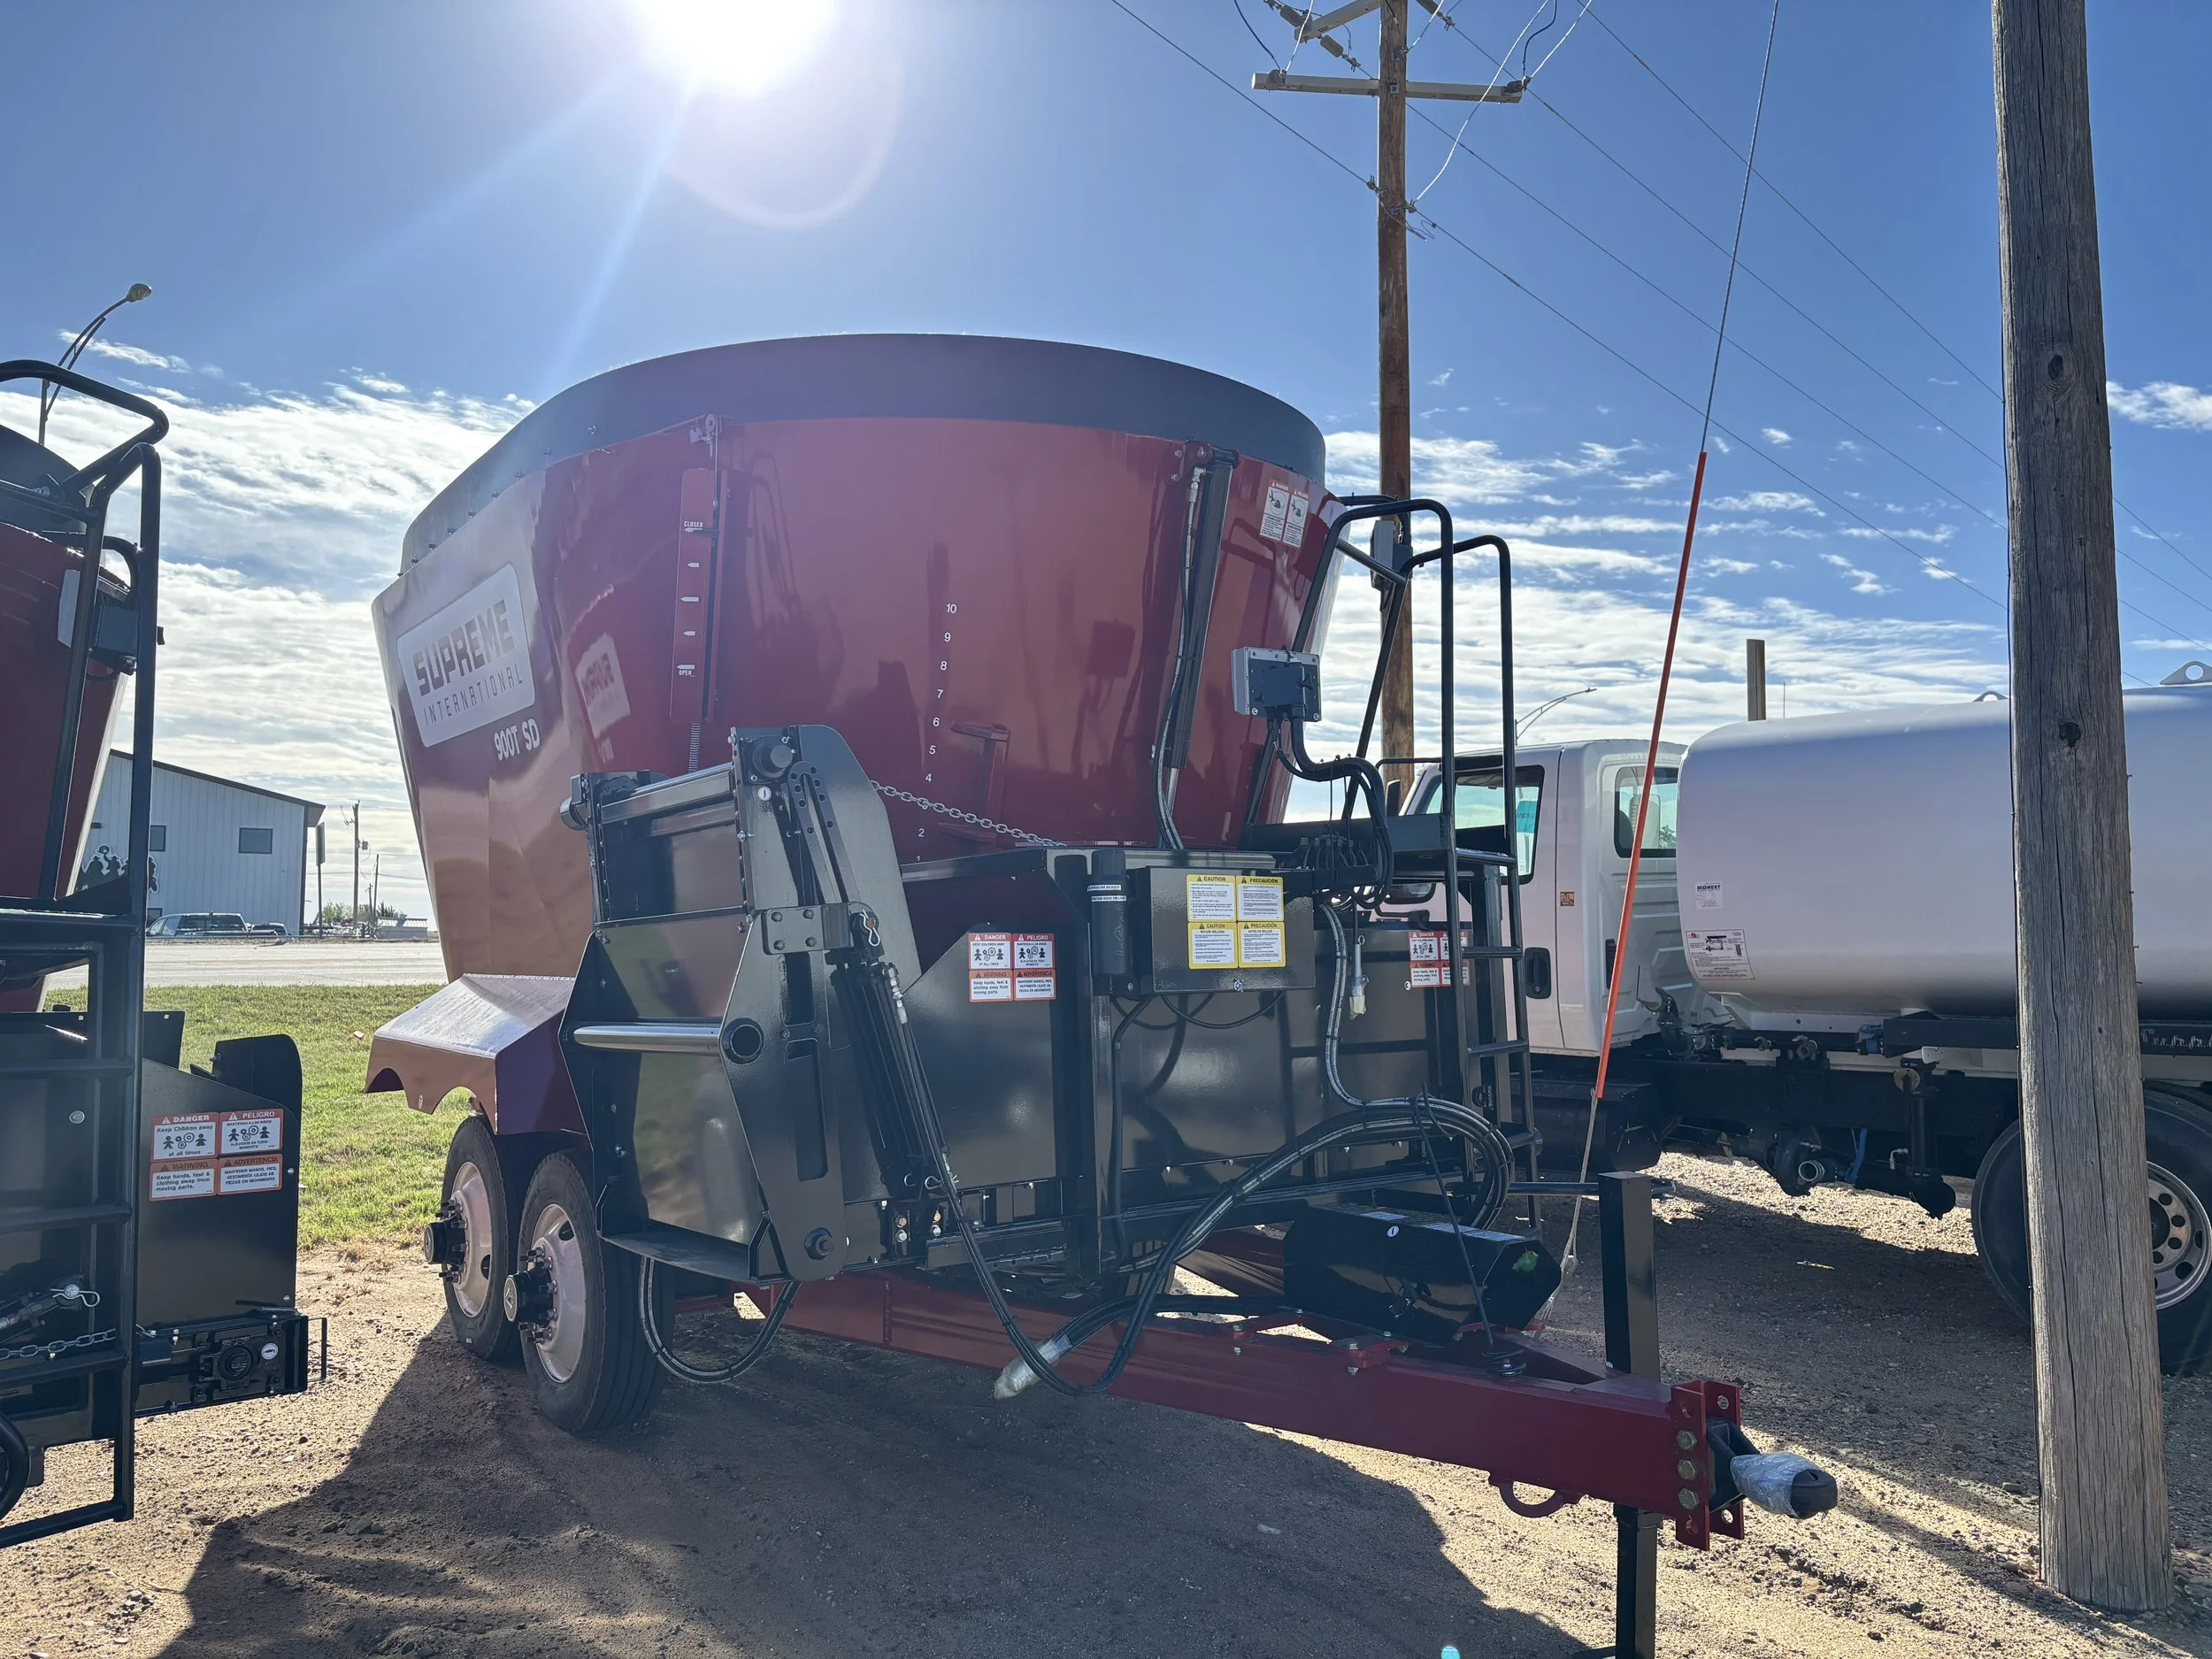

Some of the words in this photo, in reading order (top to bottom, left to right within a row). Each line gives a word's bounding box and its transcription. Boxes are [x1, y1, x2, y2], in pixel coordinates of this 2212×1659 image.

[946, 603, 957, 614] 10
[944, 632, 951, 642] 9
[412, 599, 515, 696] SUPREME
[940, 661, 947, 671] 8
[423, 663, 523, 726] INTERNATIONAL
[937, 689, 944, 699] 7
[933, 717, 940, 727] 6
[494, 726, 521, 761] 900T
[522, 718, 541, 751] SD
[929, 745, 936, 755] 5
[926, 773, 932, 783] 4
[918, 828, 925, 838] 2
